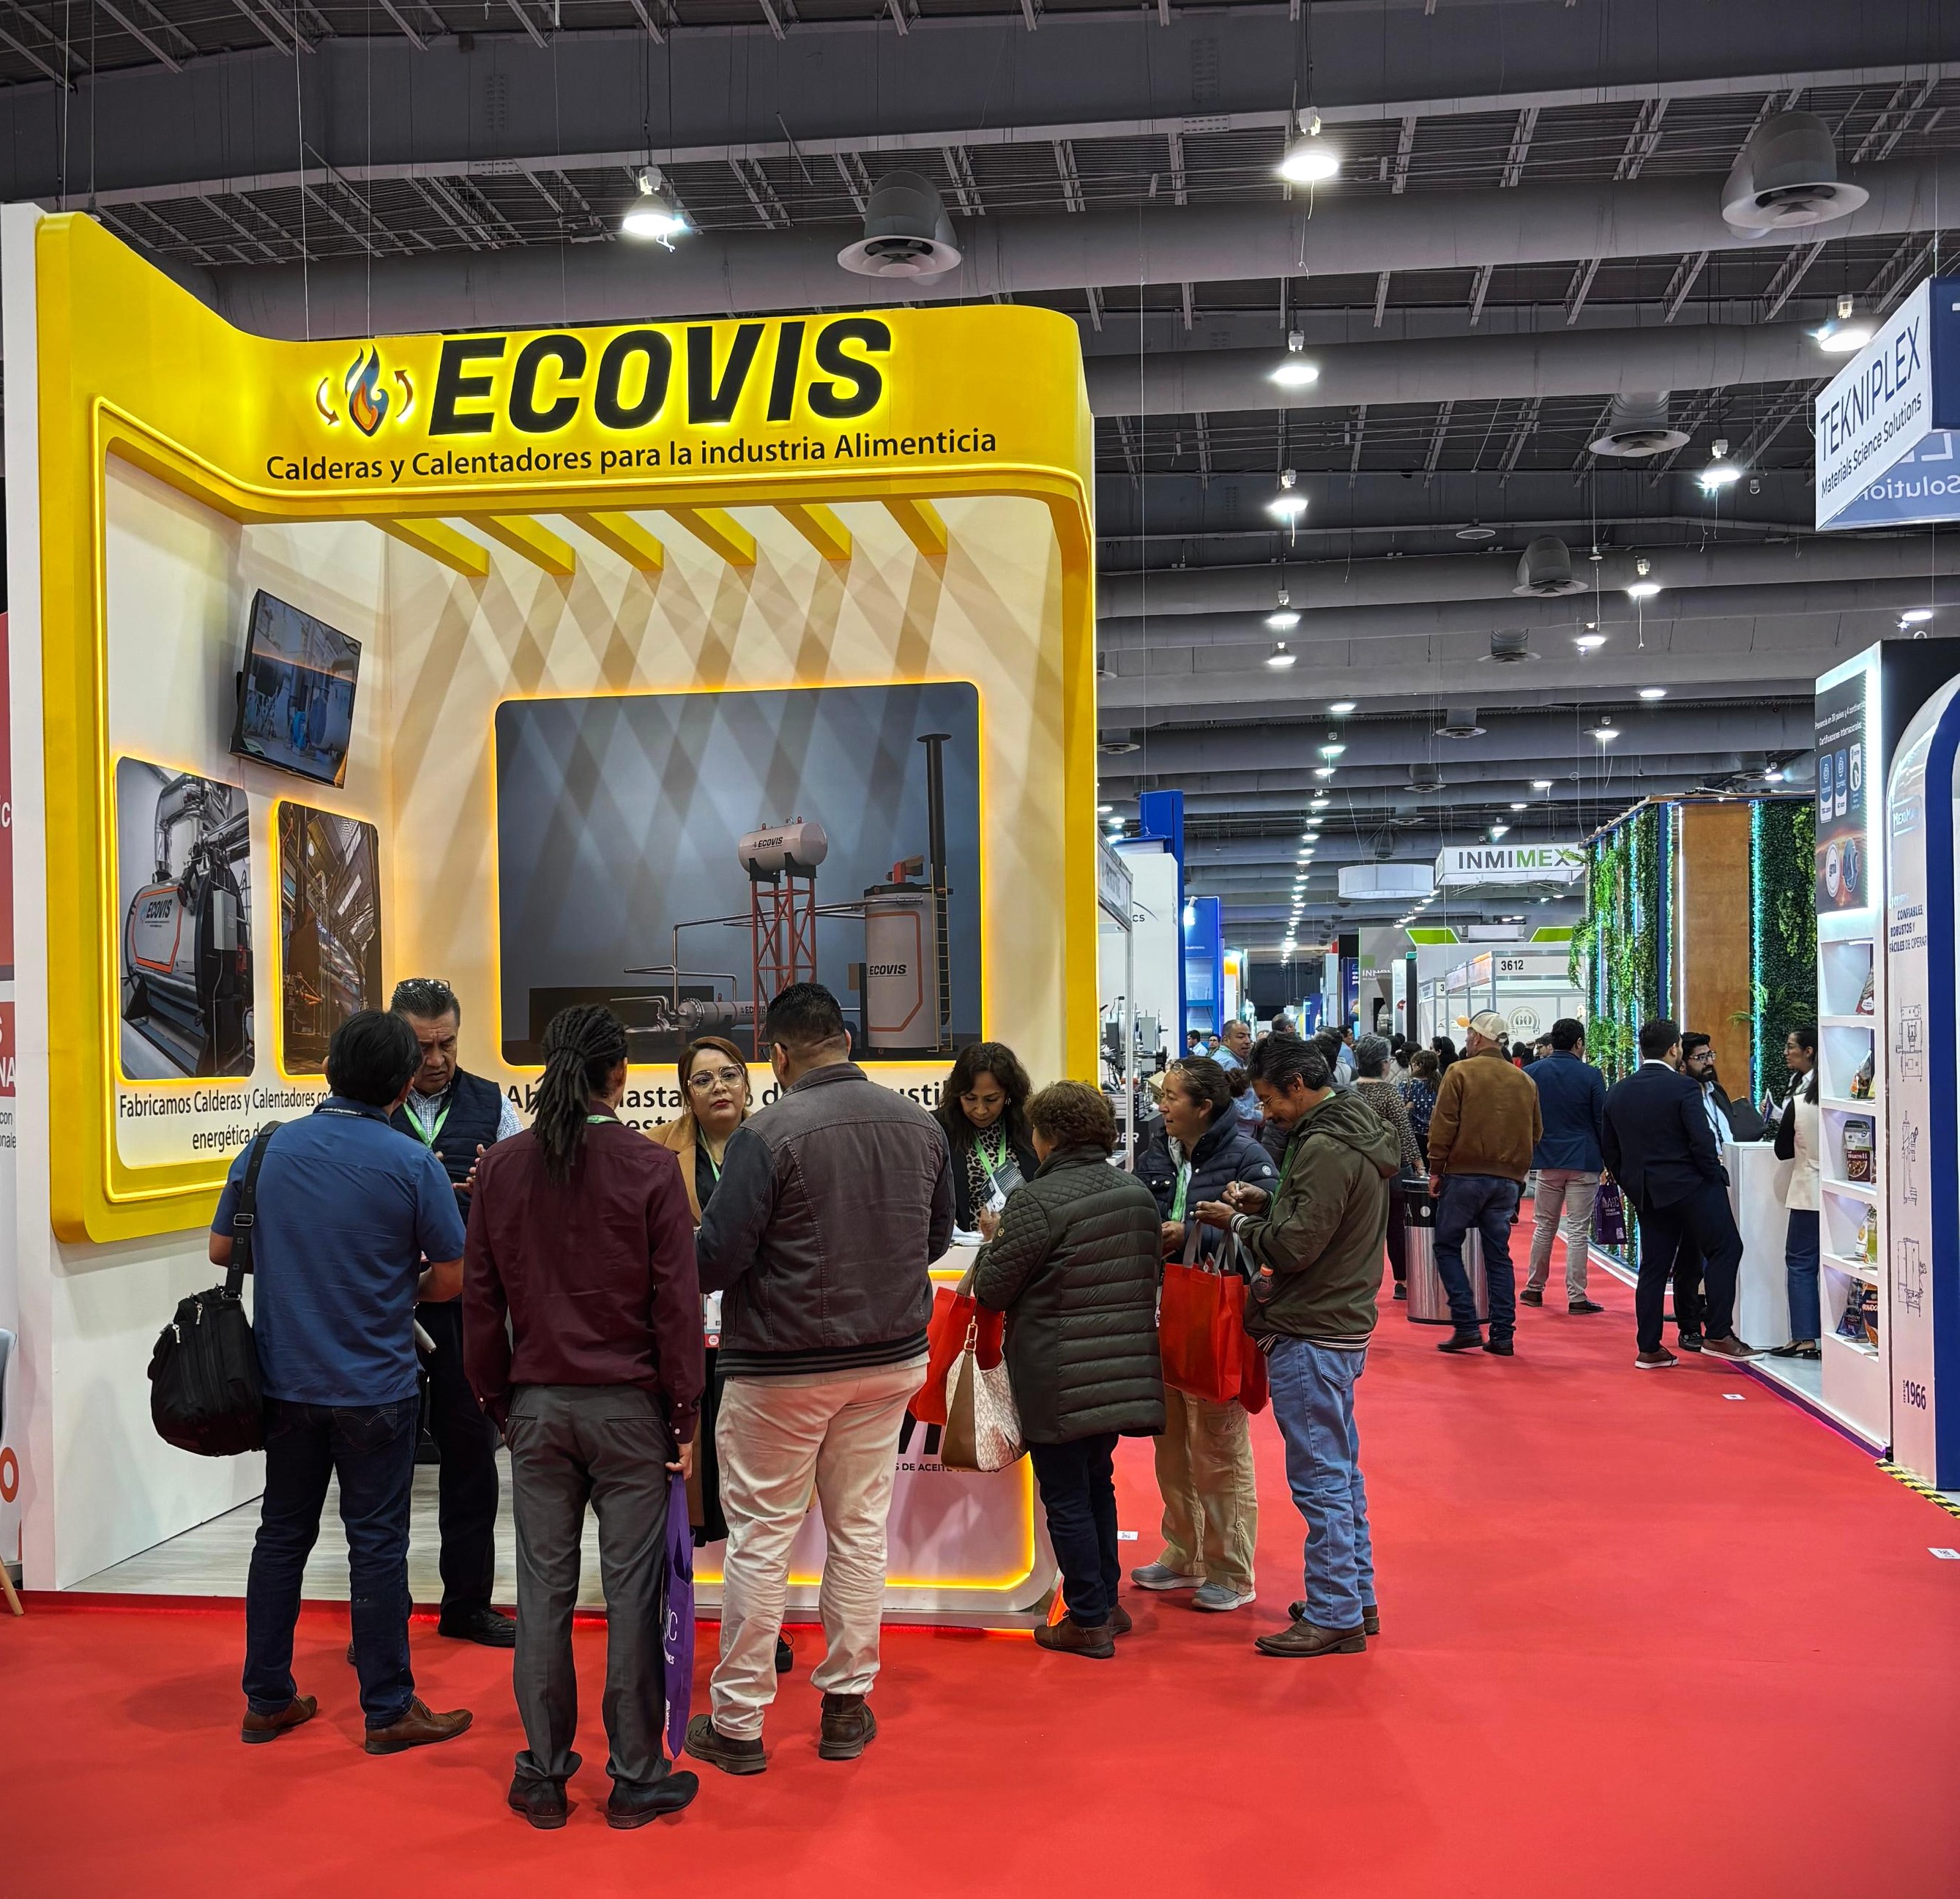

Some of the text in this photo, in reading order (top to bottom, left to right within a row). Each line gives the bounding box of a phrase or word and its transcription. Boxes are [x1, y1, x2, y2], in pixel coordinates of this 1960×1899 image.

[428, 318, 892, 436] ECOVIS
[1821, 316, 1920, 461] TEKNIPLEX
[266, 428, 996, 483] Calderas y Calentadores para la industria Alimenticia
[1822, 456, 1852, 499] Materials
[1853, 432, 1882, 472] Science
[1884, 392, 1922, 443] Solutions
[759, 837, 783, 848] ECOVIS
[1458, 848, 1570, 869] INMIMEX
[146, 899, 172, 919] ECOVIS
[1890, 922, 1912, 937] ROBUSTOS
[869, 964, 907, 975] ECOVIS
[1501, 960, 1524, 971] 3612
[1515, 1015, 1533, 1026] 60
[119, 1087, 330, 1117] Fabricamos Calderas y Calentadores co
[193, 1124, 250, 1152] energética
[1905, 1380, 1926, 1410] 1966
[902, 1463, 915, 1471] DE
